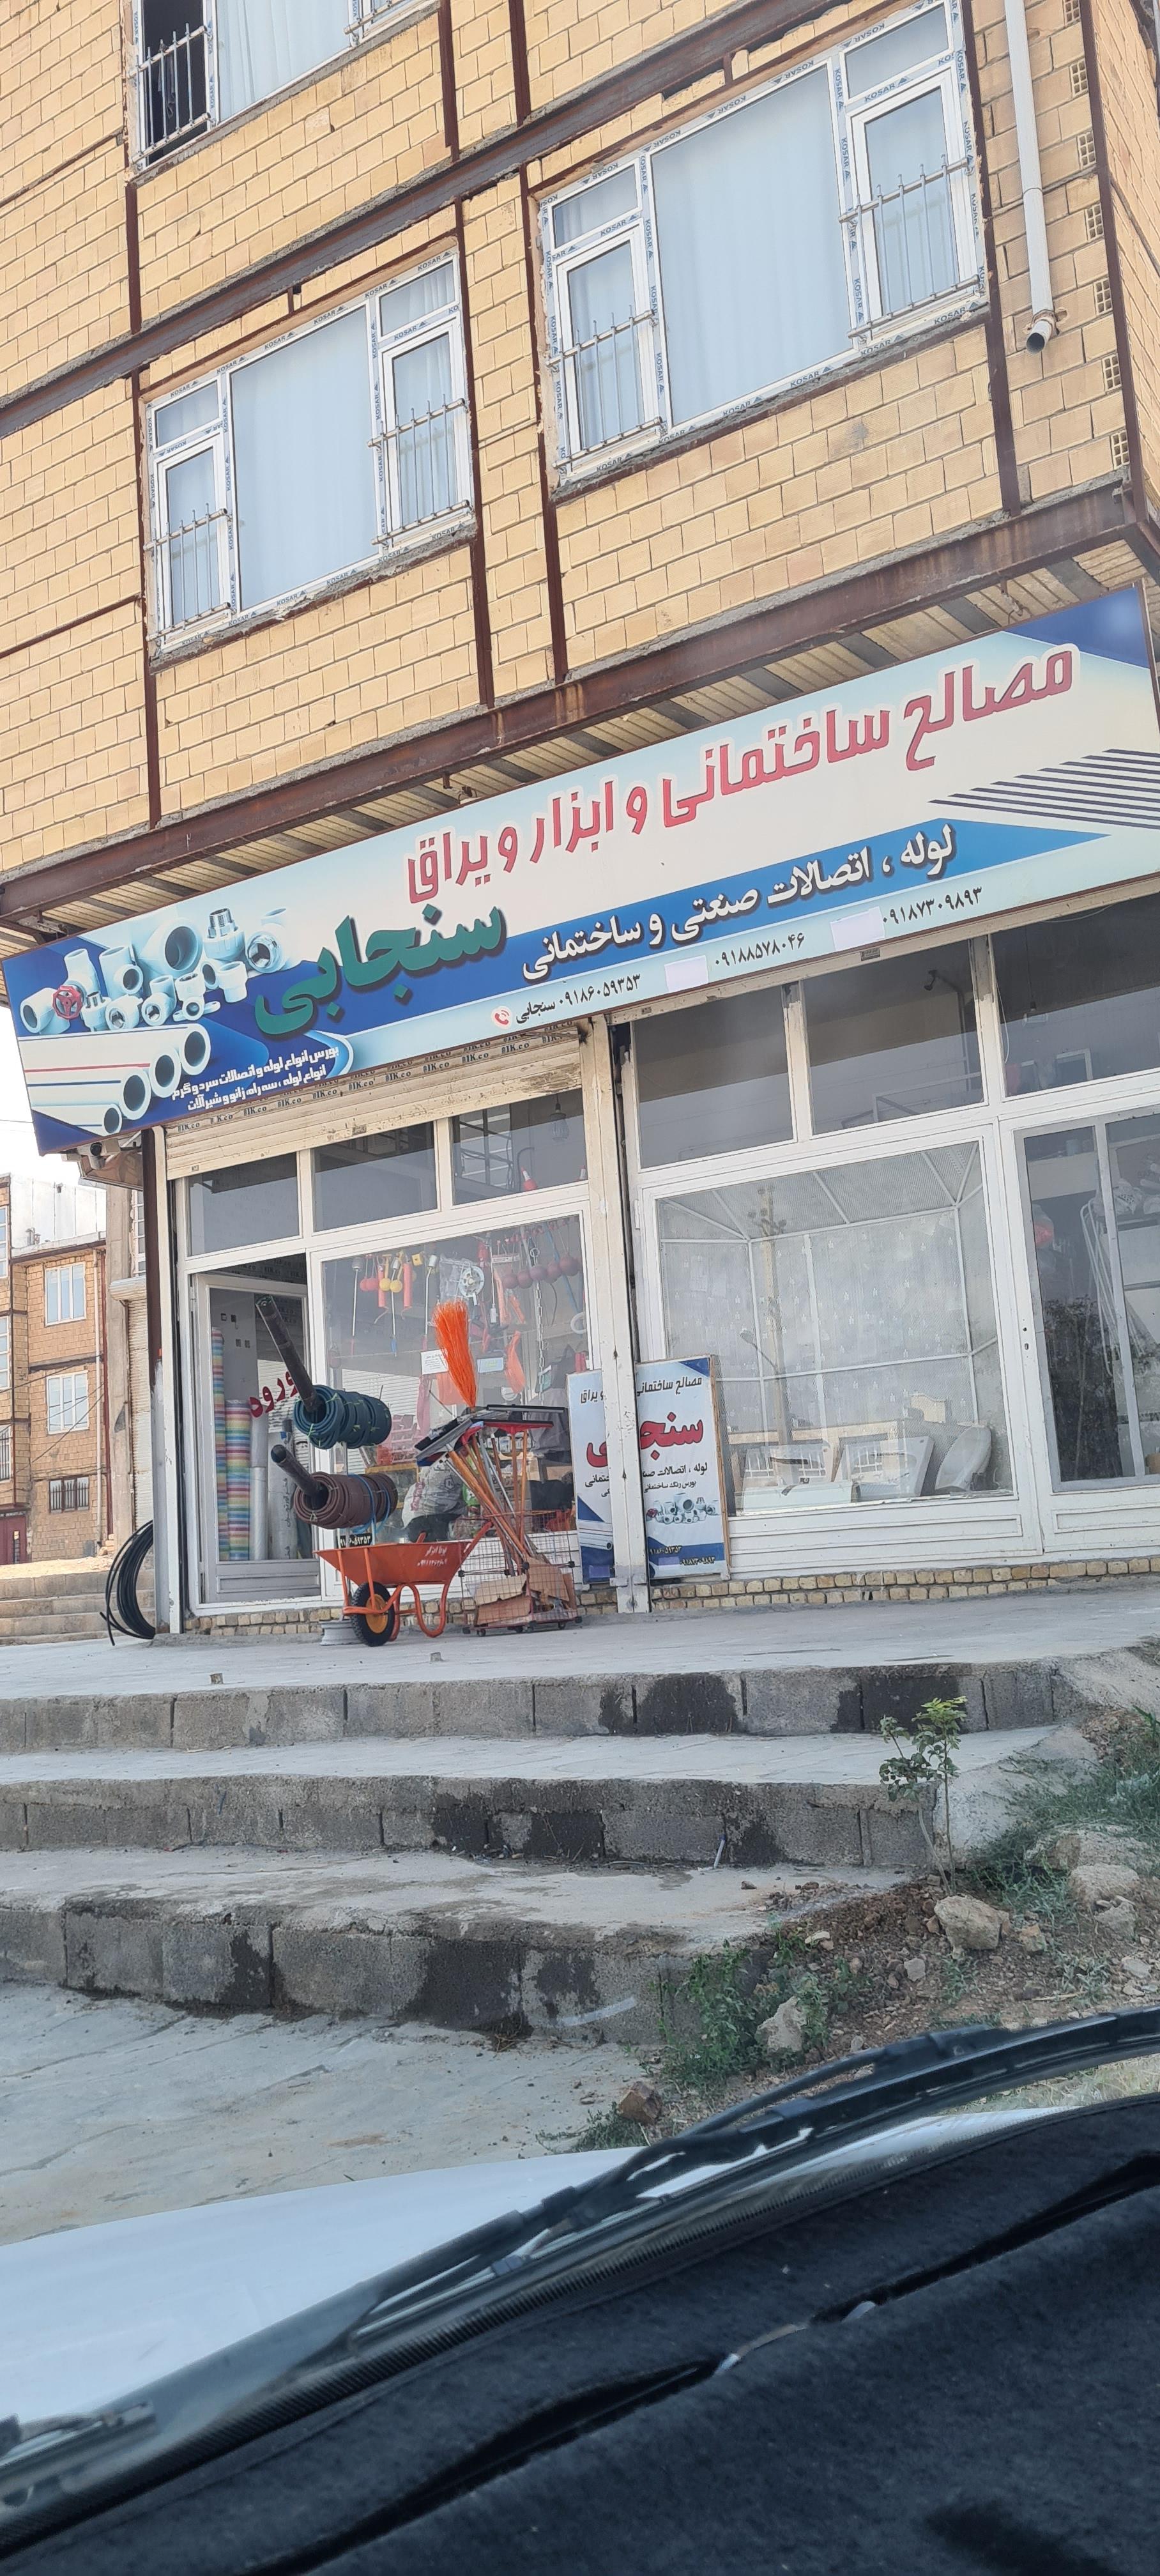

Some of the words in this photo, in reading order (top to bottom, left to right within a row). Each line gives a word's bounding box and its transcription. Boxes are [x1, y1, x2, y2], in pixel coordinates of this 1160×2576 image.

[855, 23, 885, 42] KOSAR
[786, 60, 814, 79] KOSAR
[864, 83, 895, 102] KOSAR
[717, 95, 745, 114] KOSAR
[654, 130, 681, 148] KOSAR
[592, 163, 618, 180] KOSAR
[600, 218, 626, 236] KOSAR
[418, 256, 441, 271] KOSAR
[365, 284, 387, 298] KOSAR
[853, 279, 862, 309] KOSAR
[314, 311, 335, 325] KOSAR
[935, 307, 965, 325] KOSAR
[393, 325, 418, 341] KOSAR
[264, 335, 286, 349] KOSAR
[217, 360, 237, 374] KOSAR
[790, 371, 820, 385] KOSAR
[170, 384, 191, 397] KOSAR
[722, 401, 751, 416] KOSAR
[659, 429, 685, 443] KOSAR
[166, 440, 187, 454] KOSAR
[597, 457, 622, 471] KOSAR
[432, 526, 455, 540] KOSAR
[327, 572, 348, 585] KOSAR
[277, 593, 298, 606] KOSAR
[229, 615, 249, 626] KOSAR
[904, 650, 1072, 770] مصالح
[663, 709, 890, 827] ساختمانی
[626, 786, 648, 834] و
[530, 781, 613, 863] ابزار
[498, 827, 518, 873] و
[901, 825, 953, 875] لوله
[408, 832, 491, 903] یراق
[768, 847, 869, 904] اتصالات
[671, 888, 759, 940] صنعتی
[883, 887, 982, 924] ۰۹۱۸۷۳۰۹۸۹۳
[649, 914, 662, 944] و
[523, 916, 640, 979] ساختمانی
[715, 932, 805, 966] ۰۹۱۸۸۵۷۸۰۴۶
[255, 907, 501, 1034] سنجابی
[560, 973, 641, 1006] ۰۹۱۸۶۰۵۹۳۵۳
[516, 1001, 556, 1023] سنجابی
[284, 1050, 308, 1070] انواع
[309, 1046, 339, 1063] بورس
[256, 1068, 263, 1077] و
[264, 1057, 283, 1072] لوله
[220, 1064, 255, 1085] اتصالات
[284, 1071, 301, 1087] لوله
[303, 1064, 326, 1084] انواع
[172, 1084, 192, 1100] گرم
[193, 1085, 199, 1094] و
[199, 1078, 218, 1092] سرد
[262, 1082, 277, 1091] سه
[222, 1094, 230, 1104] و
[230, 1087, 247, 1101] زانو
[250, 1371, 298, 1418] ورود
[675, 1377, 702, 1395] مصالح
[581, 1389, 598, 1403] یراق
[657, 1465, 686, 1476] اتصالات
[694, 1462, 708, 1475] لوله
